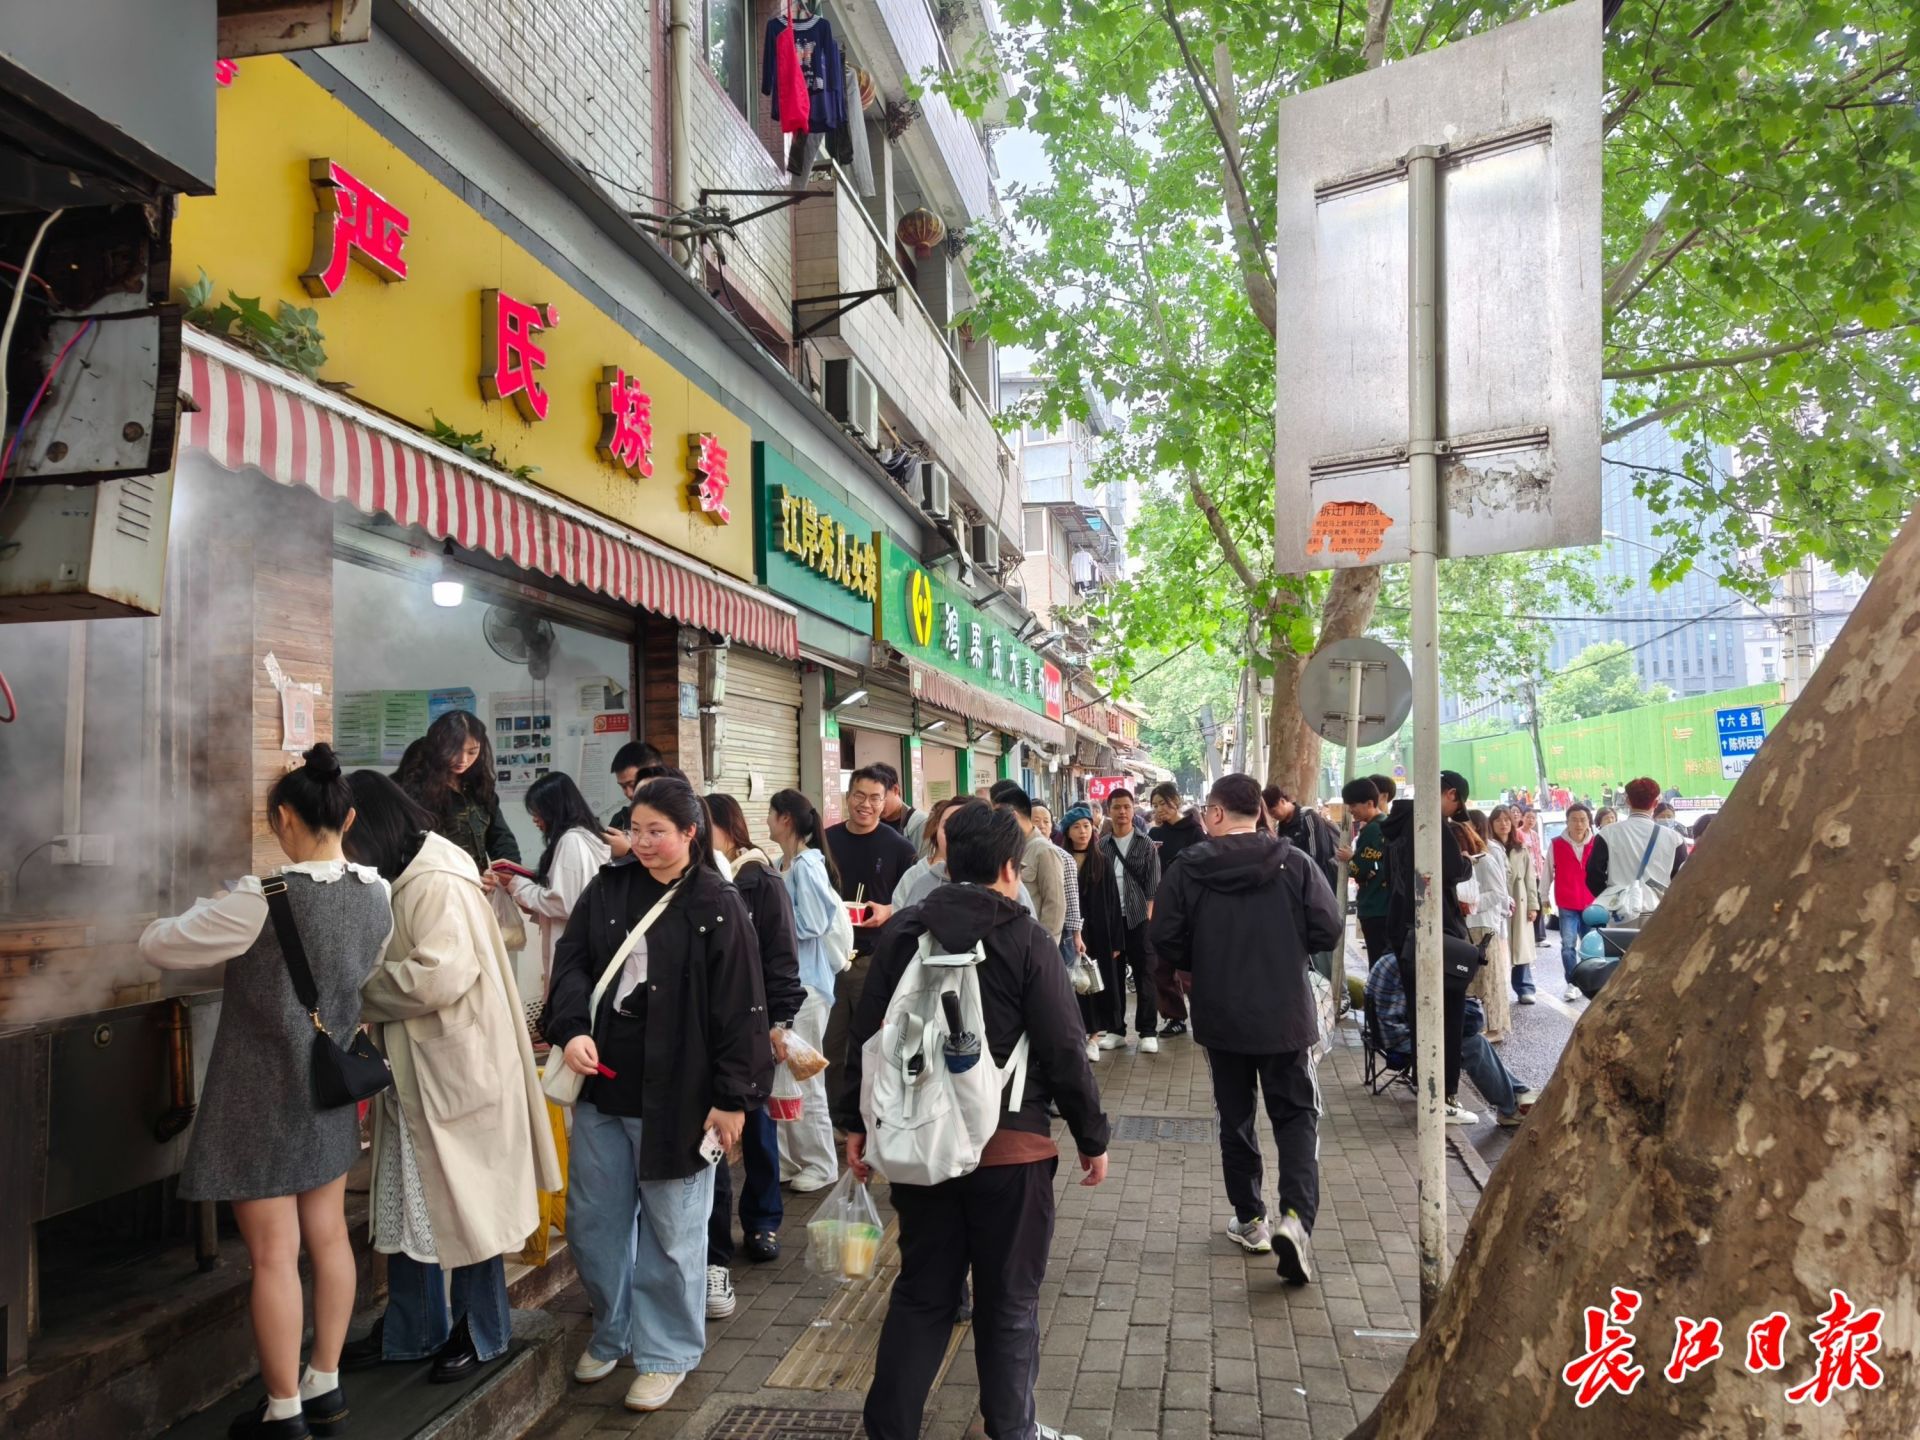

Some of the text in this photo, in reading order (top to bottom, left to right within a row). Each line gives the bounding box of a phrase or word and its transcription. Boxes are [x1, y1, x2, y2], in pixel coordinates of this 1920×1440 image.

[1320, 504, 1385, 517] 拆迁门面急
[780, 483, 877, 603] 江岸秀儿女装
[1726, 711, 1761, 728] 六合路
[1728, 735, 1764, 752] 陈怀民路
